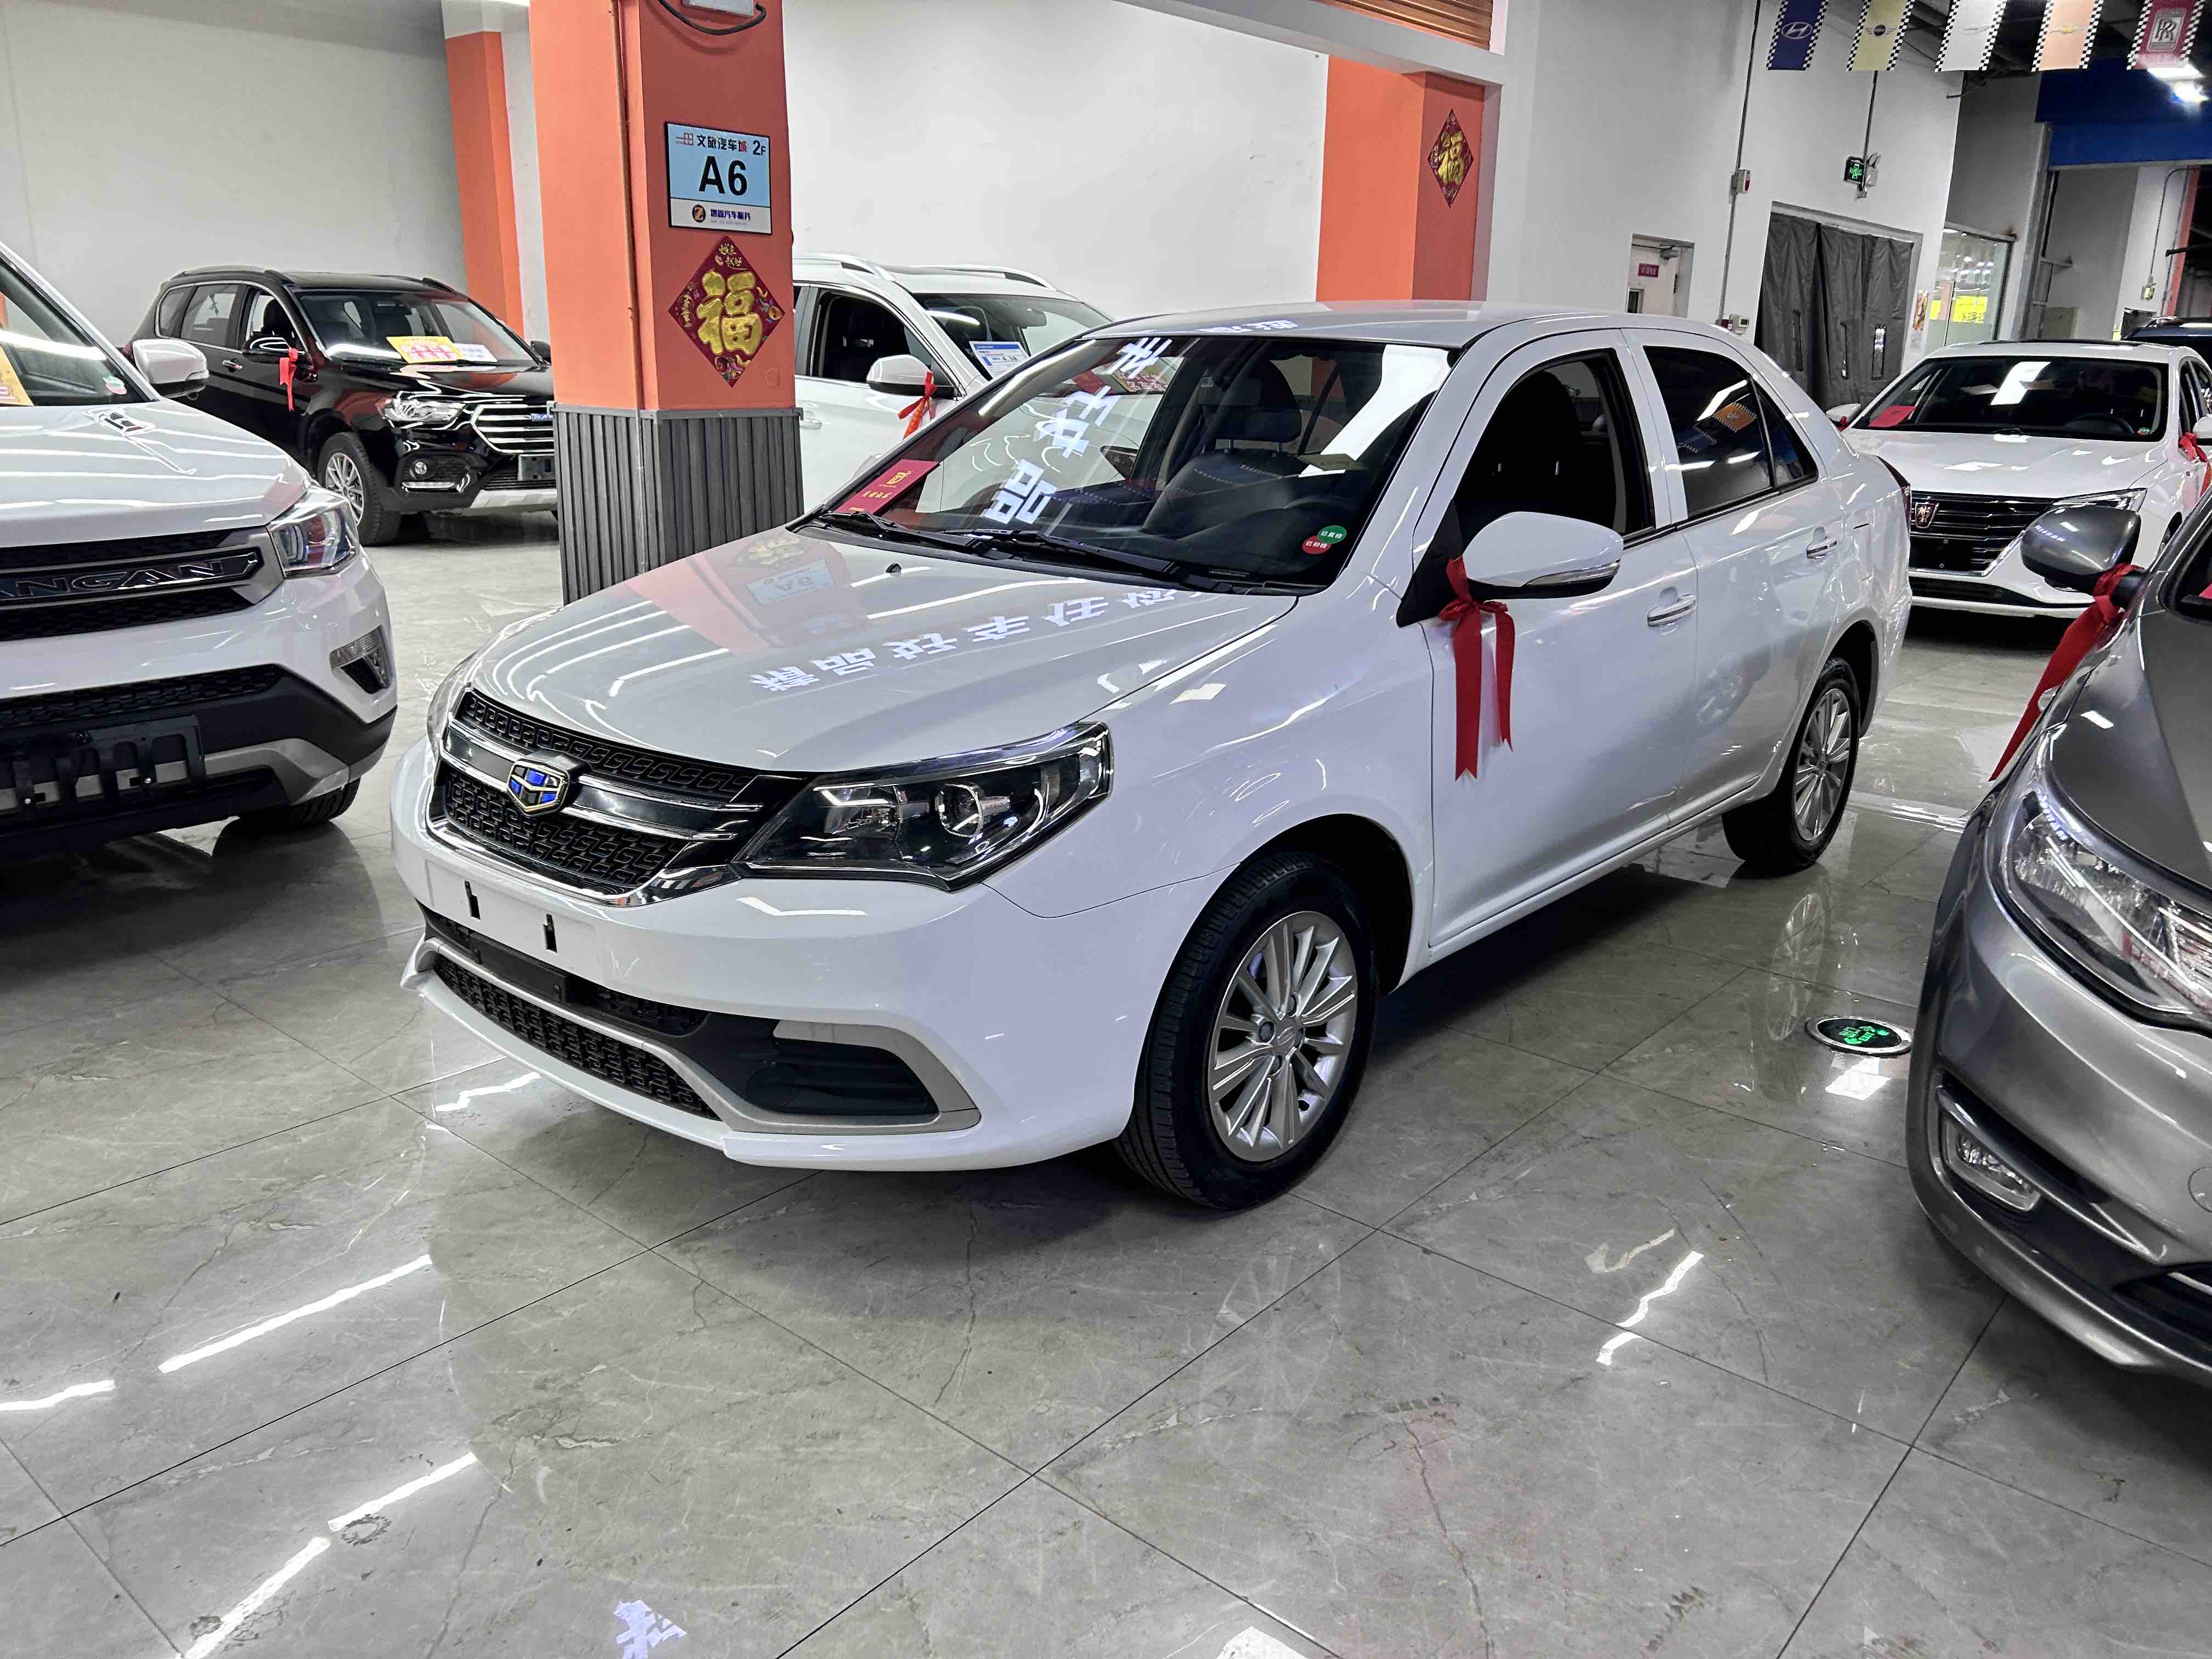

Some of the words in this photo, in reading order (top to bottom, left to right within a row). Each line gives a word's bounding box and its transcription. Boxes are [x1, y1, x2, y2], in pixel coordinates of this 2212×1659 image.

[752, 140, 766, 156] 2F
[699, 155, 747, 196] A6
[696, 269, 764, 356] 福
[0, 561, 224, 597] NGAN
